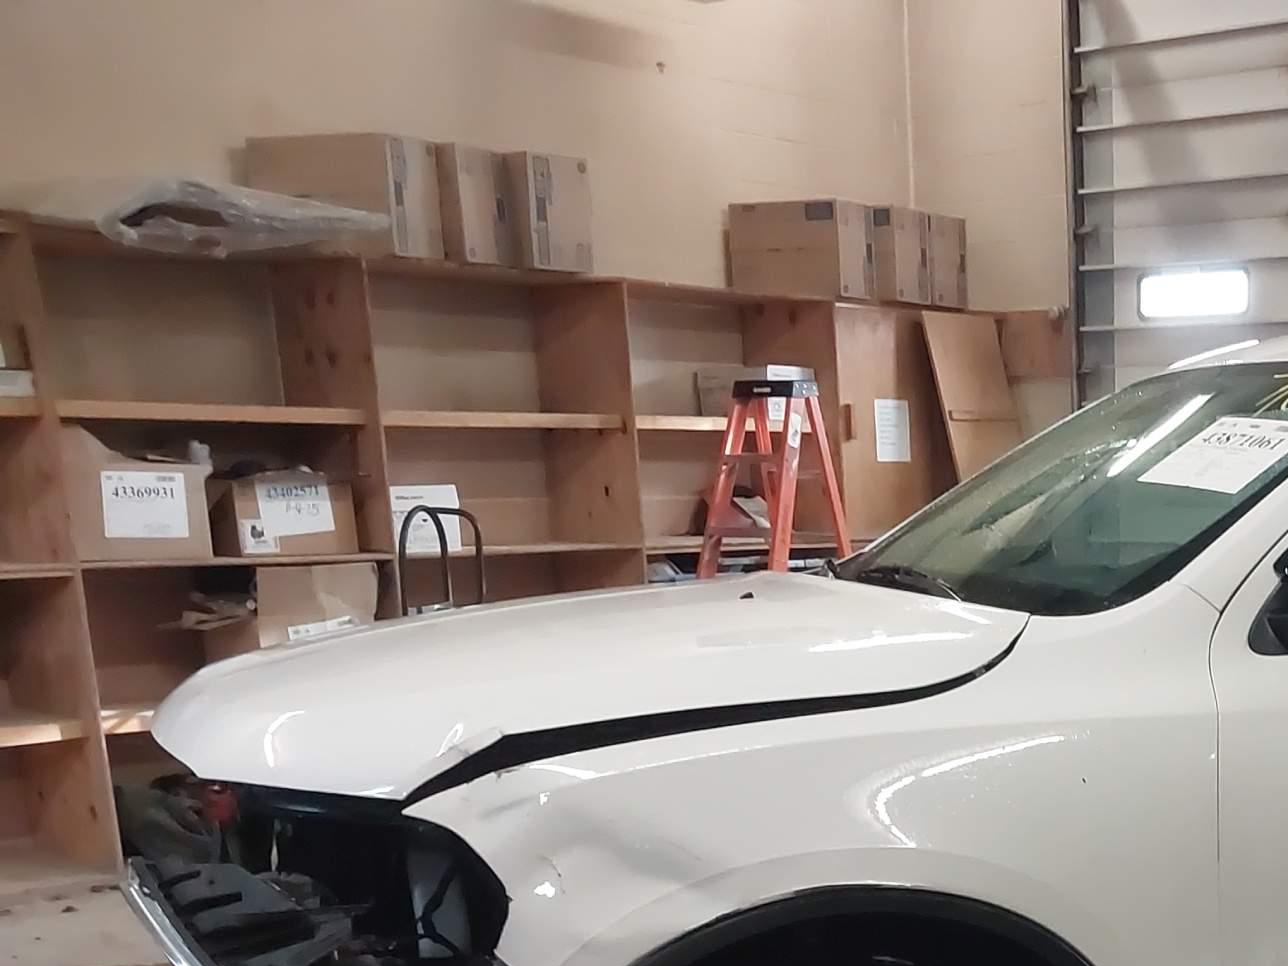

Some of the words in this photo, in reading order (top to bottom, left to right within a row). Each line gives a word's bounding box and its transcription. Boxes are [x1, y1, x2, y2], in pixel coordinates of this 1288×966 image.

[1202, 432, 1286, 450] 43871061
[112, 486, 174, 499] 43369931
[265, 484, 320, 499] 43402571
